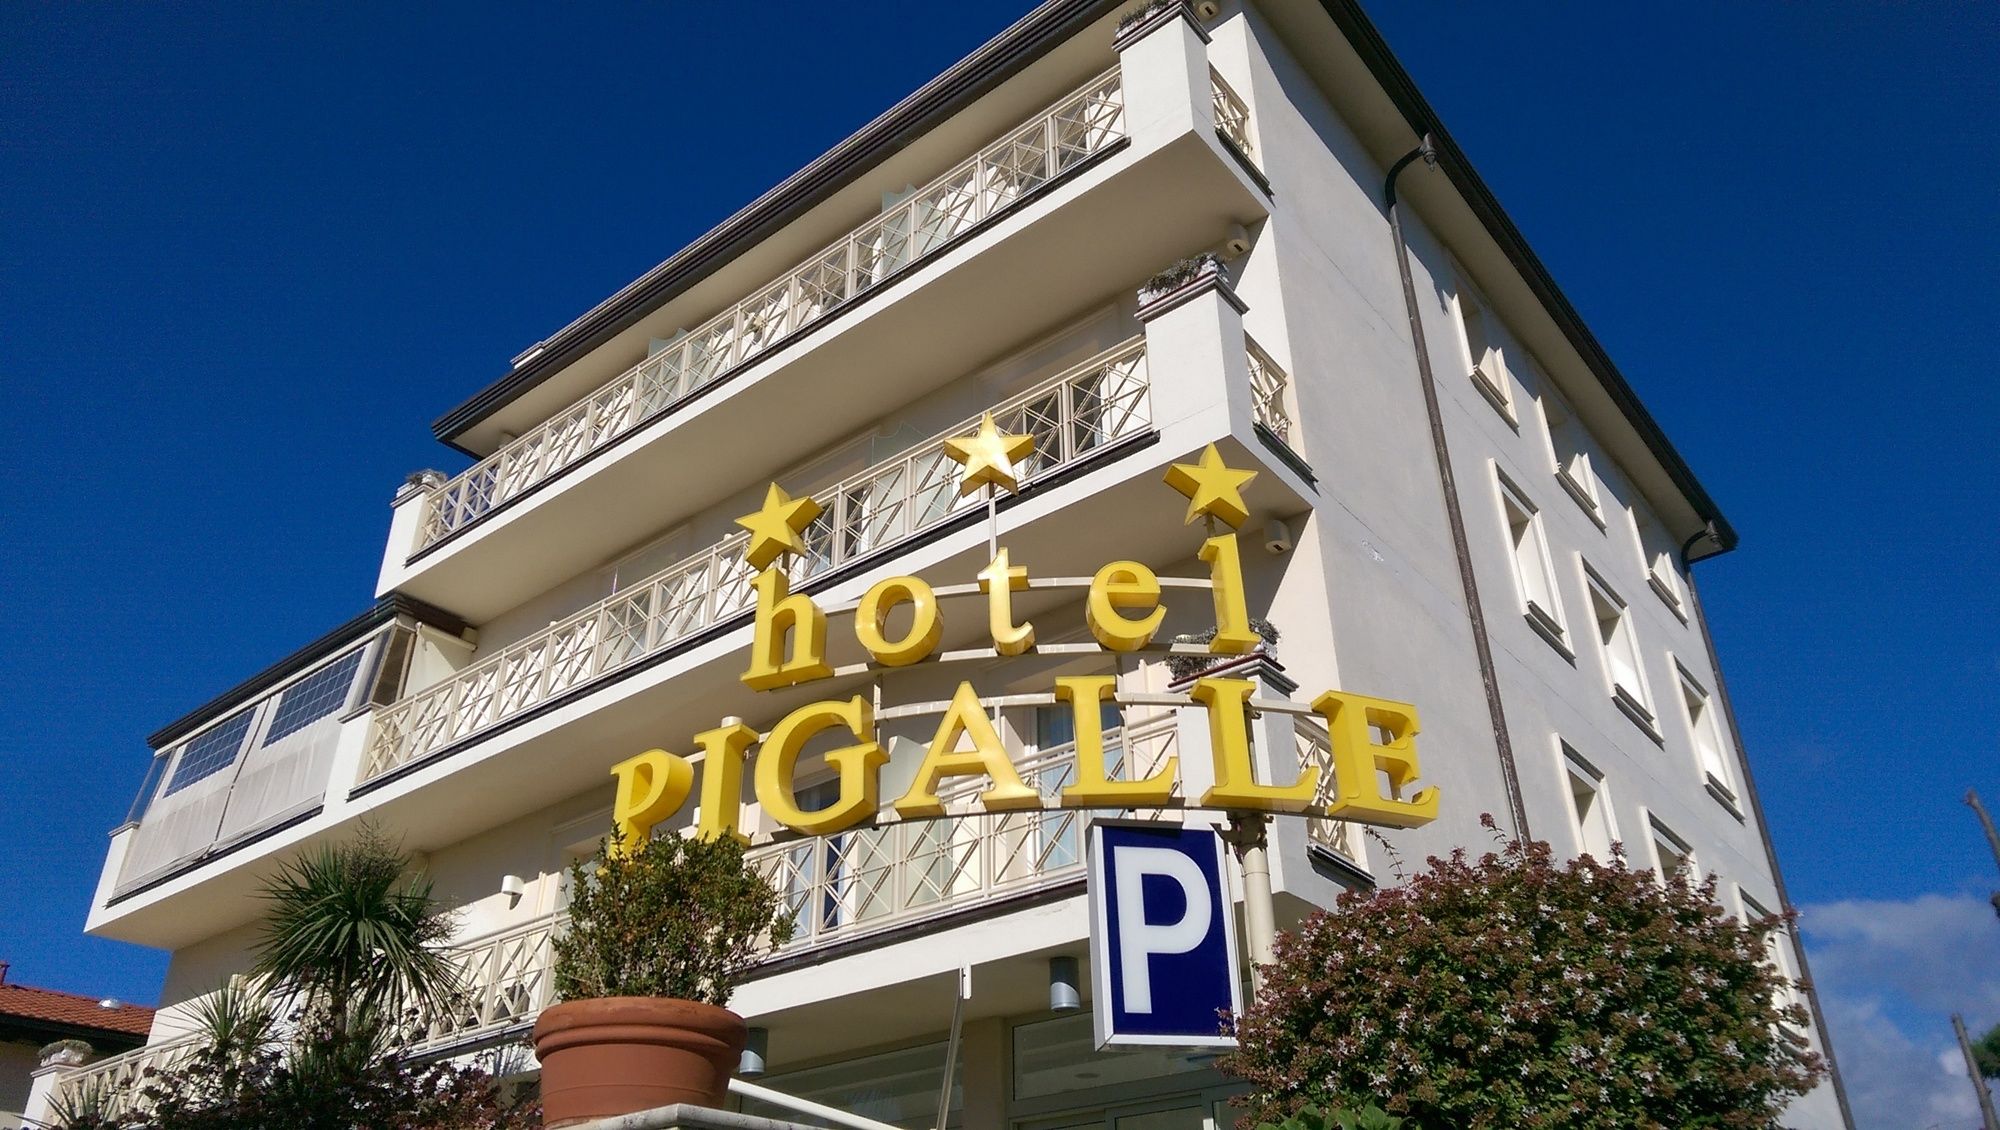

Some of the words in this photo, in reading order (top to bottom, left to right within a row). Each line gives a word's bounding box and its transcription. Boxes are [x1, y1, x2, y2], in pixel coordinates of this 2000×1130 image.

[740, 533, 1260, 691] hotel
[604, 675, 1440, 864] PIGALLE
[1114, 846, 1212, 1014] P
